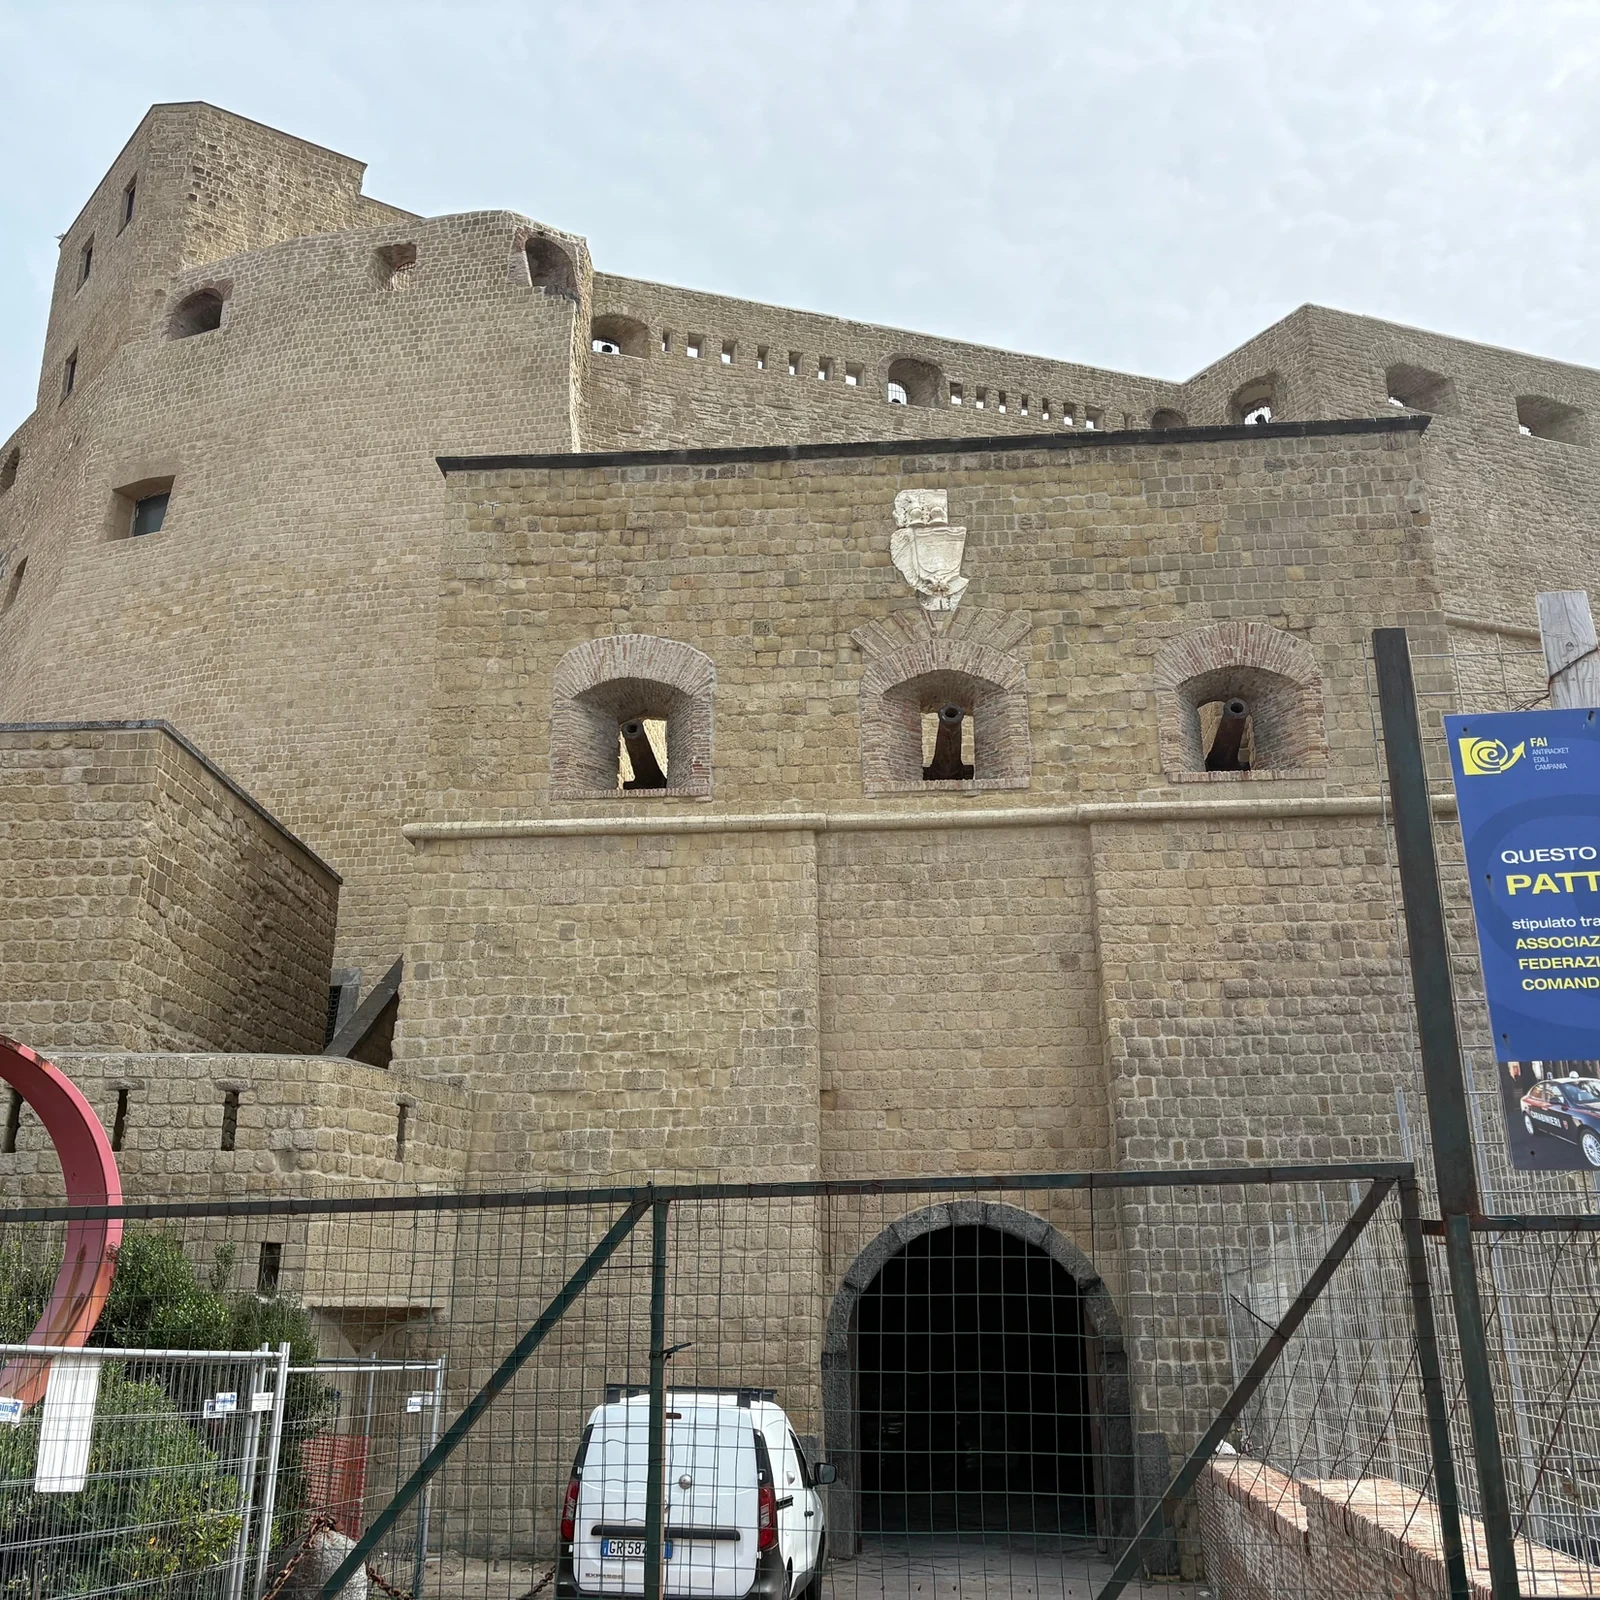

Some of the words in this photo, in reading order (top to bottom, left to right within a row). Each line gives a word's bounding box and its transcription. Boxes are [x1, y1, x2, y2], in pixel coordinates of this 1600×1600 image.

[1530, 737, 1548, 747] FAI
[1532, 747, 1569, 755] ANTIRACKET
[1535, 763, 1568, 771] CAMPANIA
[1501, 846, 1597, 865] QUESTO
[1512, 917, 1577, 931] stipulato
[1580, 916, 1600, 928] tra
